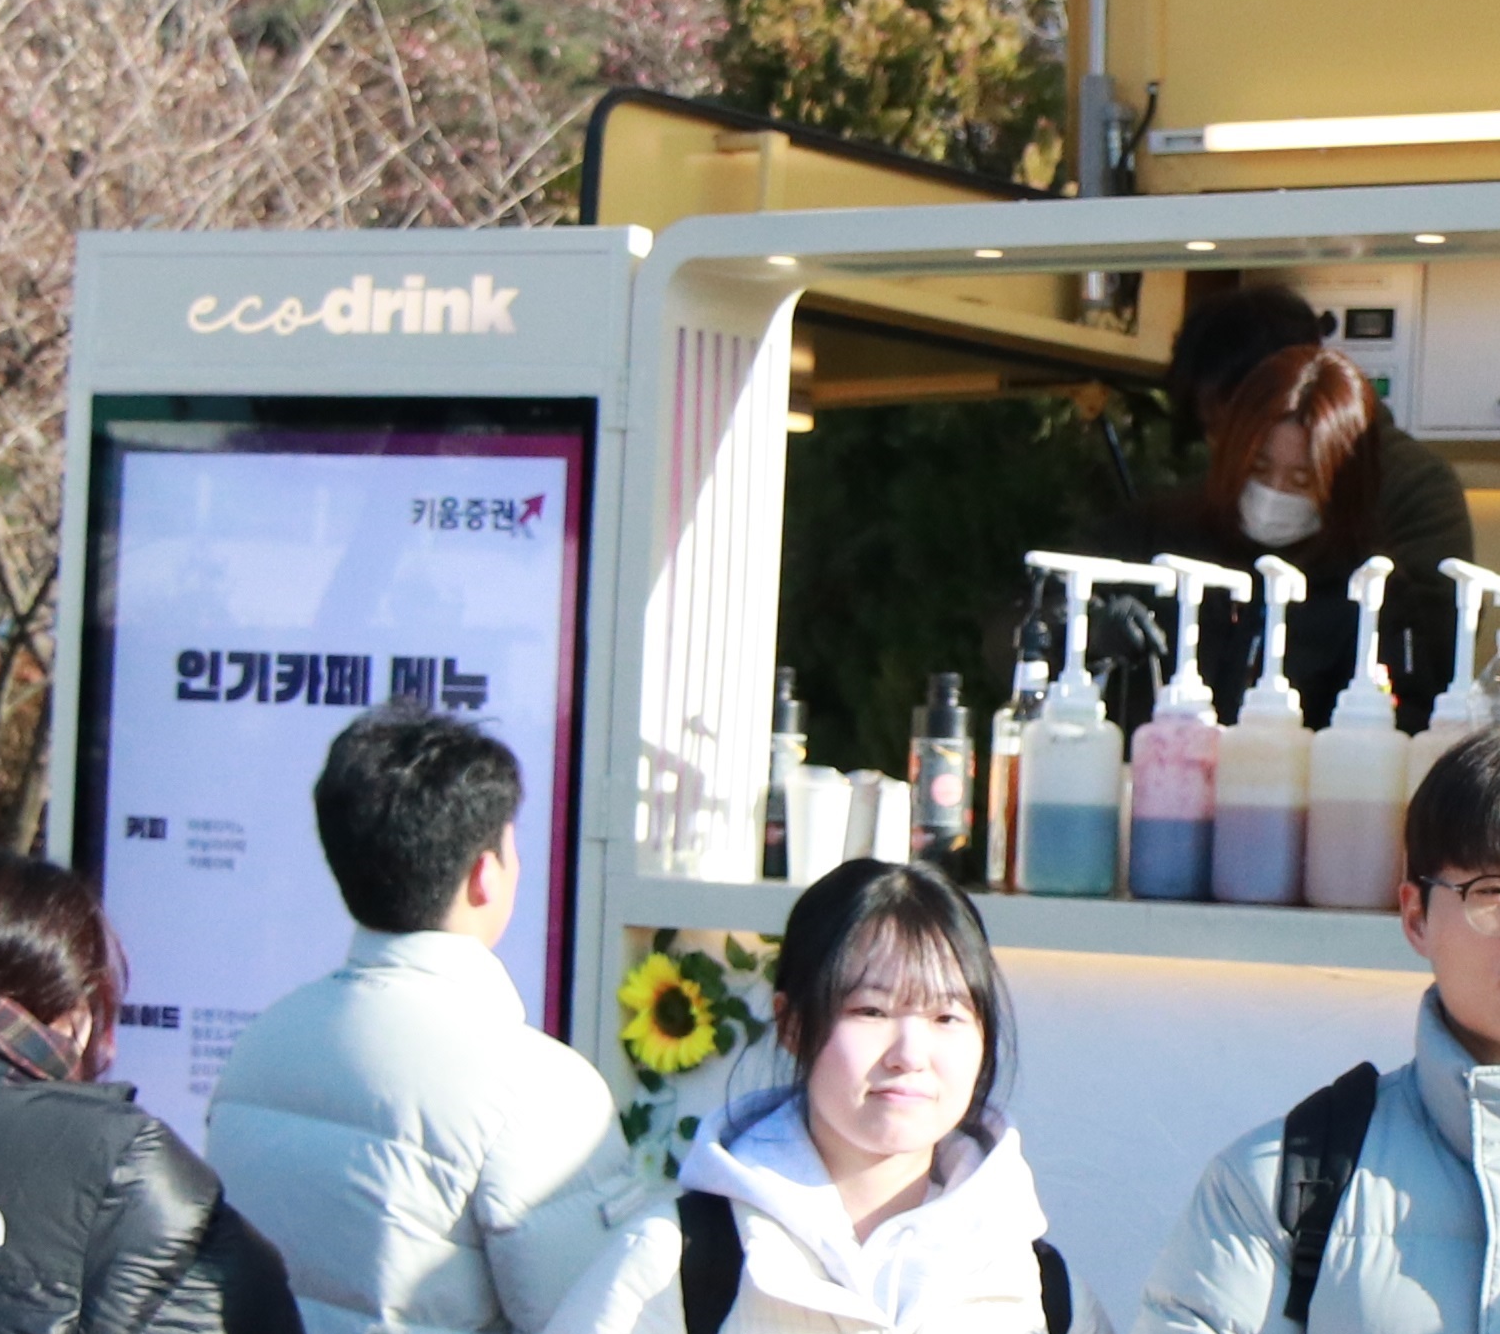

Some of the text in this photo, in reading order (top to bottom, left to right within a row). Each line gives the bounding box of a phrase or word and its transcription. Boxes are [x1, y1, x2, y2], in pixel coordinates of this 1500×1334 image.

[411, 497, 514, 532] 키움증권
[176, 650, 488, 710] 인기카페 메뉴
